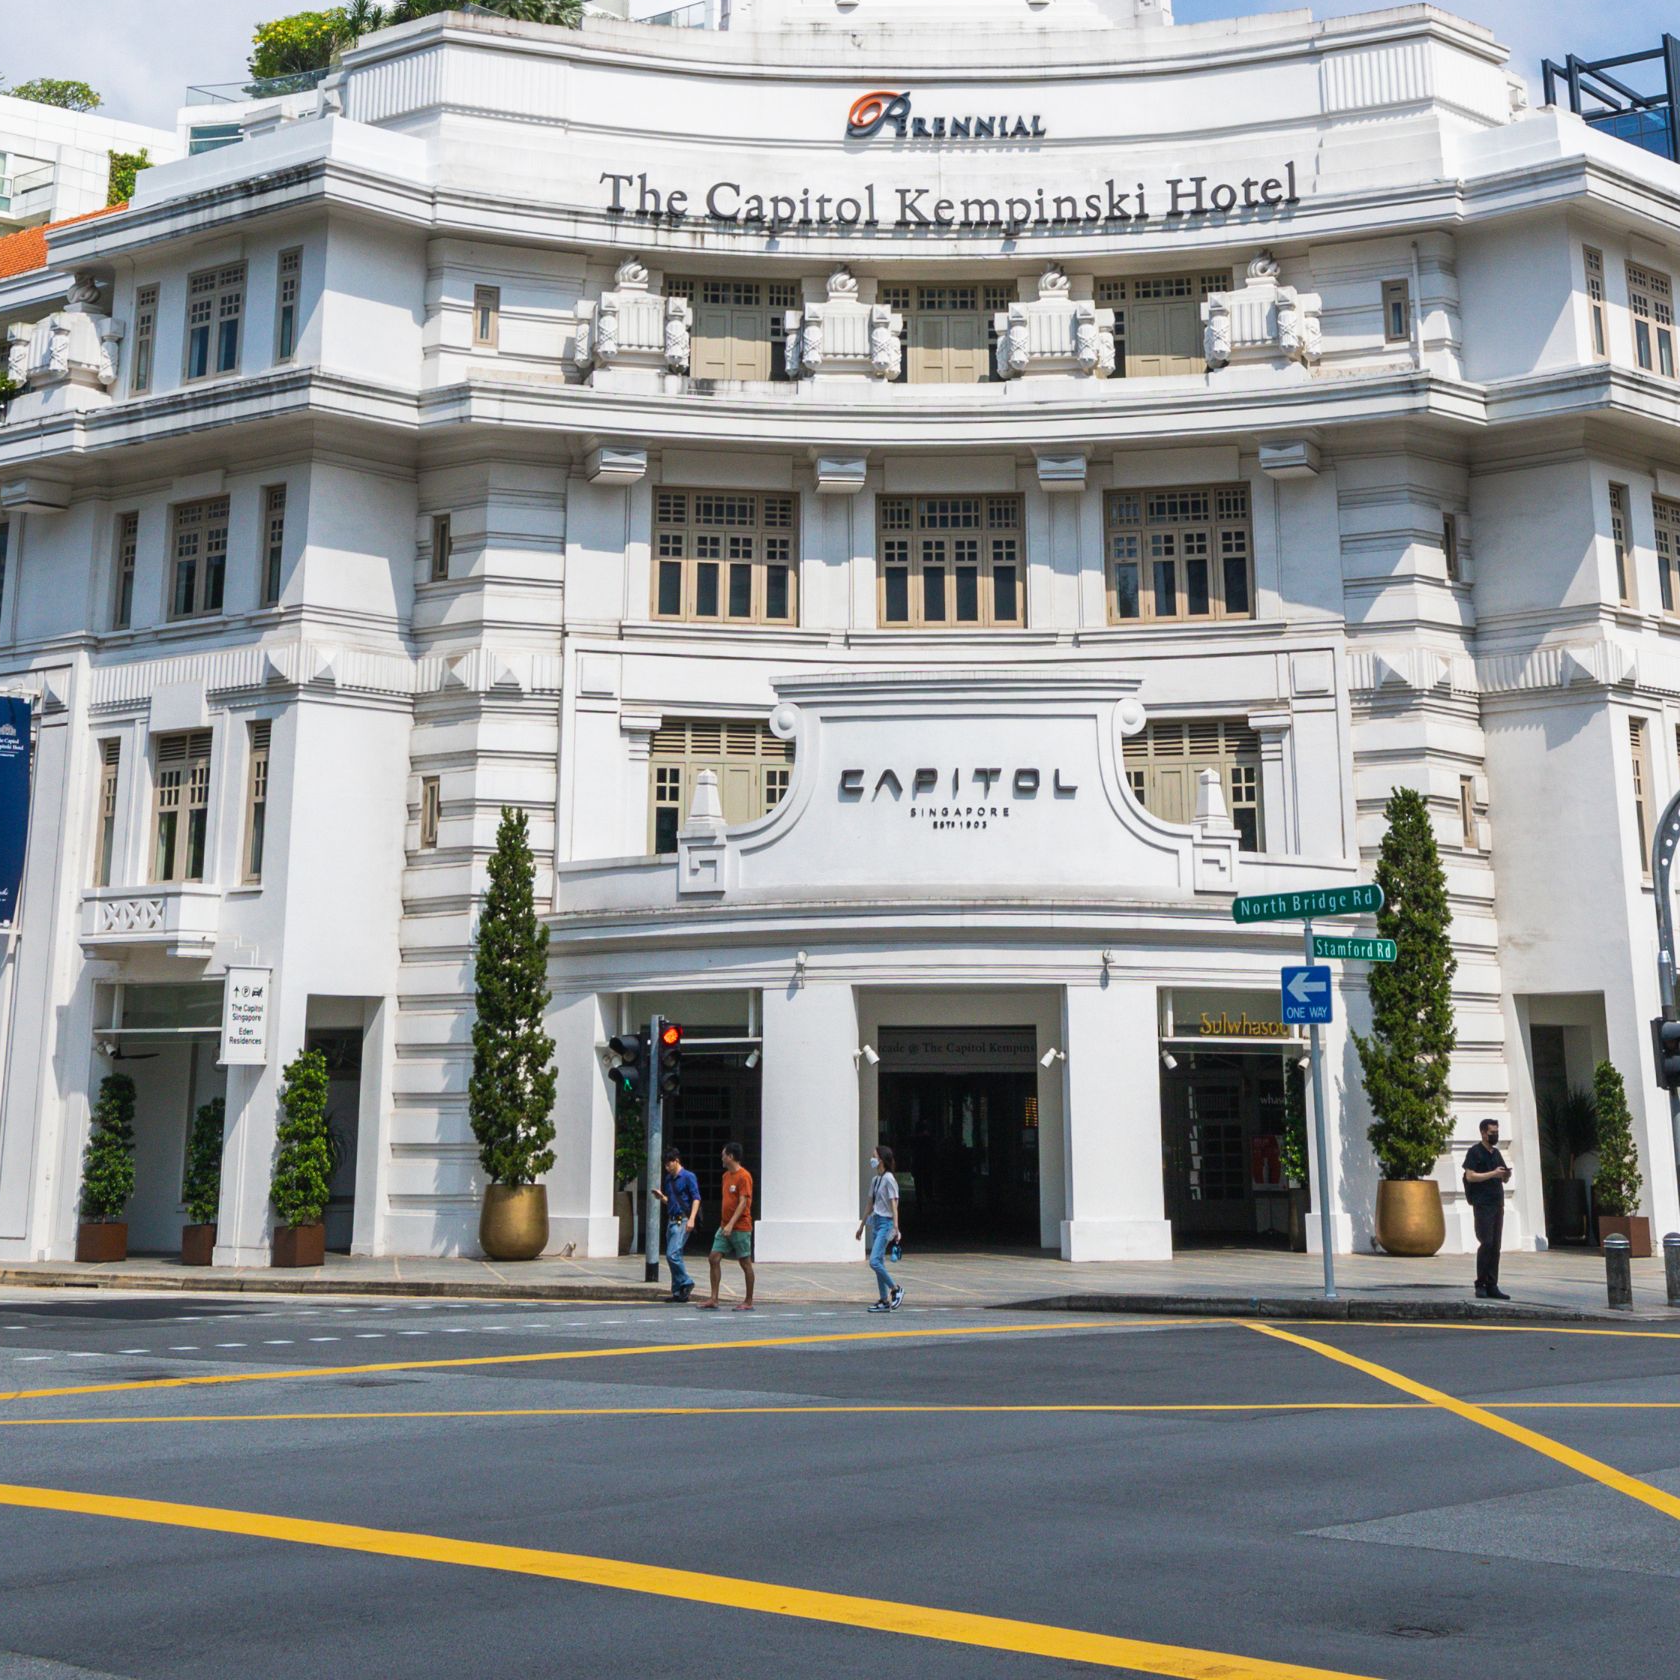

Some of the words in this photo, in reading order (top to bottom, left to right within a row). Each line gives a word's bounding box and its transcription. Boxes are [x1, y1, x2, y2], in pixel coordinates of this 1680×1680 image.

[846, 91, 1047, 138] PERENNIAL
[599, 171, 689, 217] The
[706, 182, 879, 235] Capitol
[894, 178, 1150, 236] Kempinski
[1166, 160, 1301, 217] Hotel
[840, 767, 1079, 793] CAPITOL
[910, 807, 1010, 818] SINGAPORE
[1240, 897, 1287, 917] North
[1293, 893, 1347, 912] Bridge
[1353, 889, 1373, 906] Rd
[1316, 938, 1374, 958] Stamford
[1377, 943, 1391, 959] Rd
[231, 1003, 242, 1011] The
[243, 1004, 263, 1013] Capitol
[1286, 1007, 1305, 1019] ONE
[1309, 1006, 1328, 1018] WAY
[232, 1013, 262, 1023] Singapore
[1200, 1012, 1290, 1036] Sulwhasoo
[238, 1027, 253, 1035] Eden
[229, 1036, 262, 1045] Residences
[946, 1042, 986, 1055] Capitol
[989, 1042, 1036, 1055] Kempins
